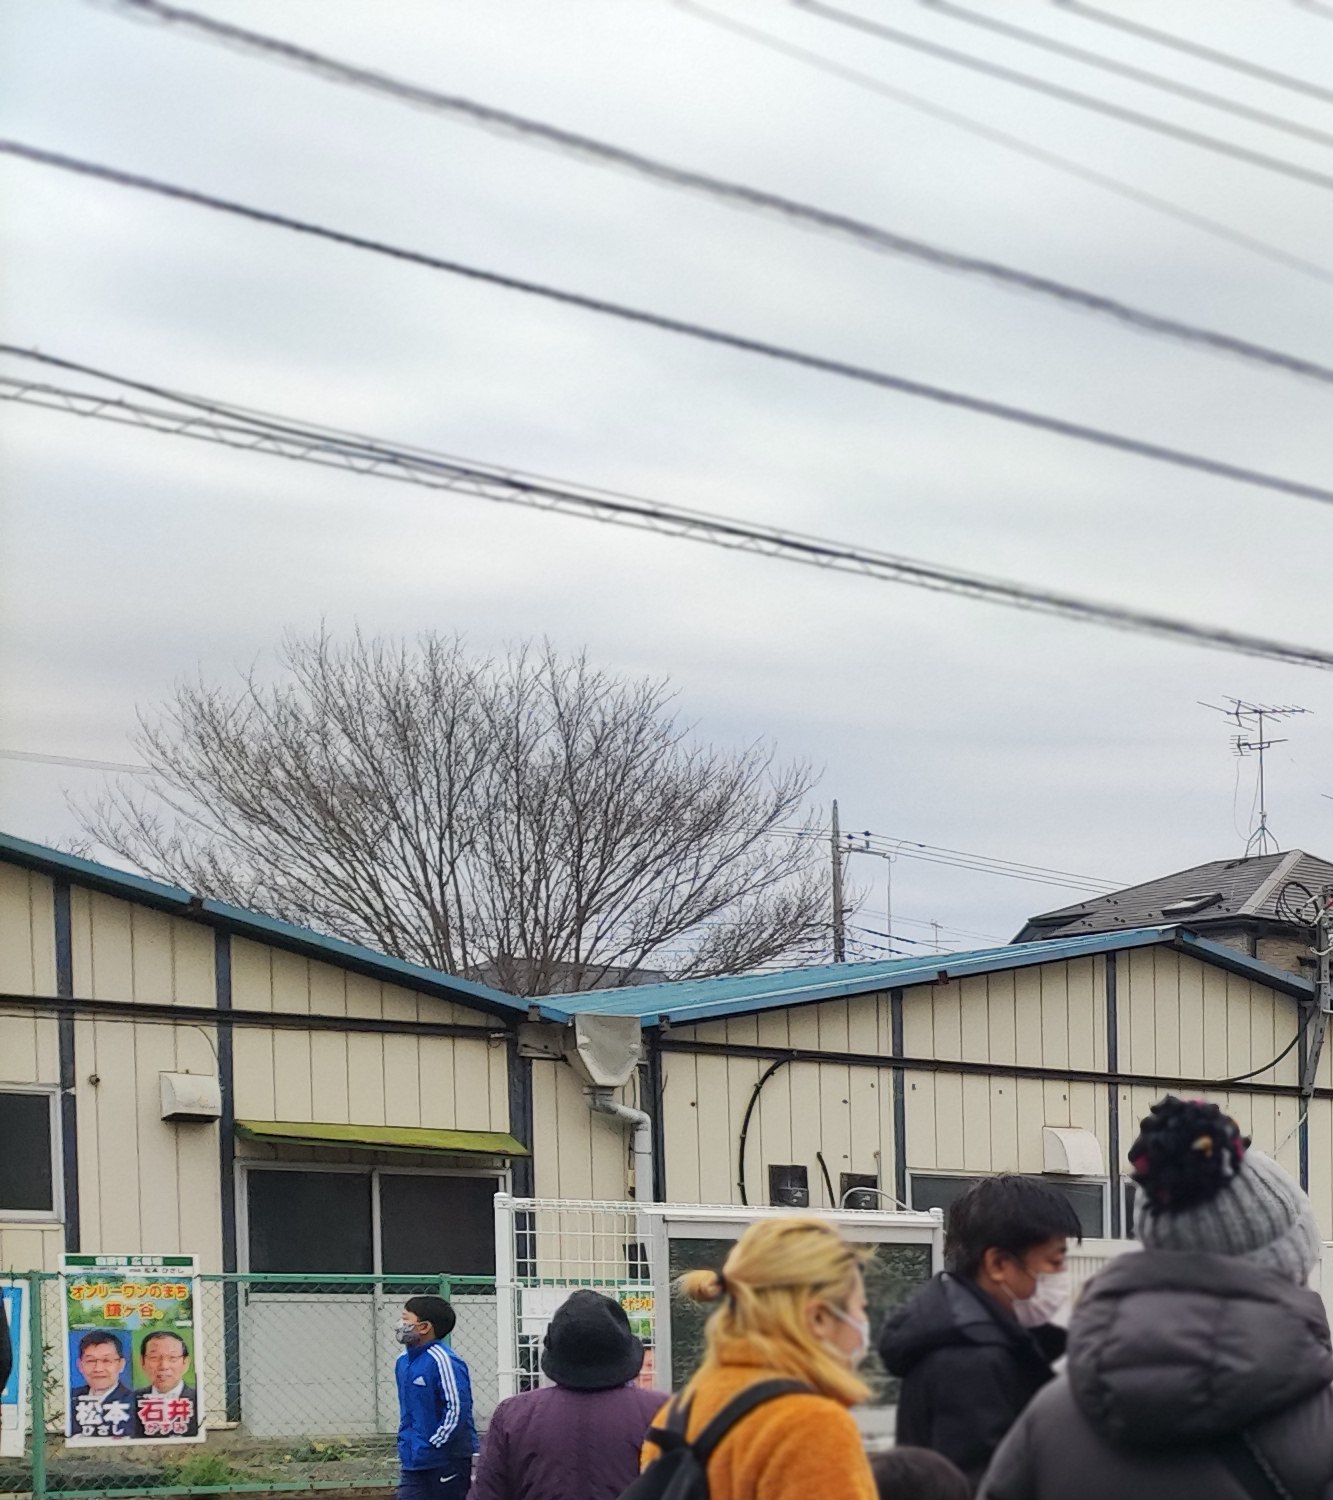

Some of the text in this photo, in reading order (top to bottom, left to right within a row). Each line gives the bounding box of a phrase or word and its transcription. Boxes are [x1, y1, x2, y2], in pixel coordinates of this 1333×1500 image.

[71, 1284, 189, 1300] オンリーワンのまち
[75, 1401, 130, 1425] 松本
[138, 1398, 193, 1424] 石井
[82, 1424, 124, 1436] ひさし
